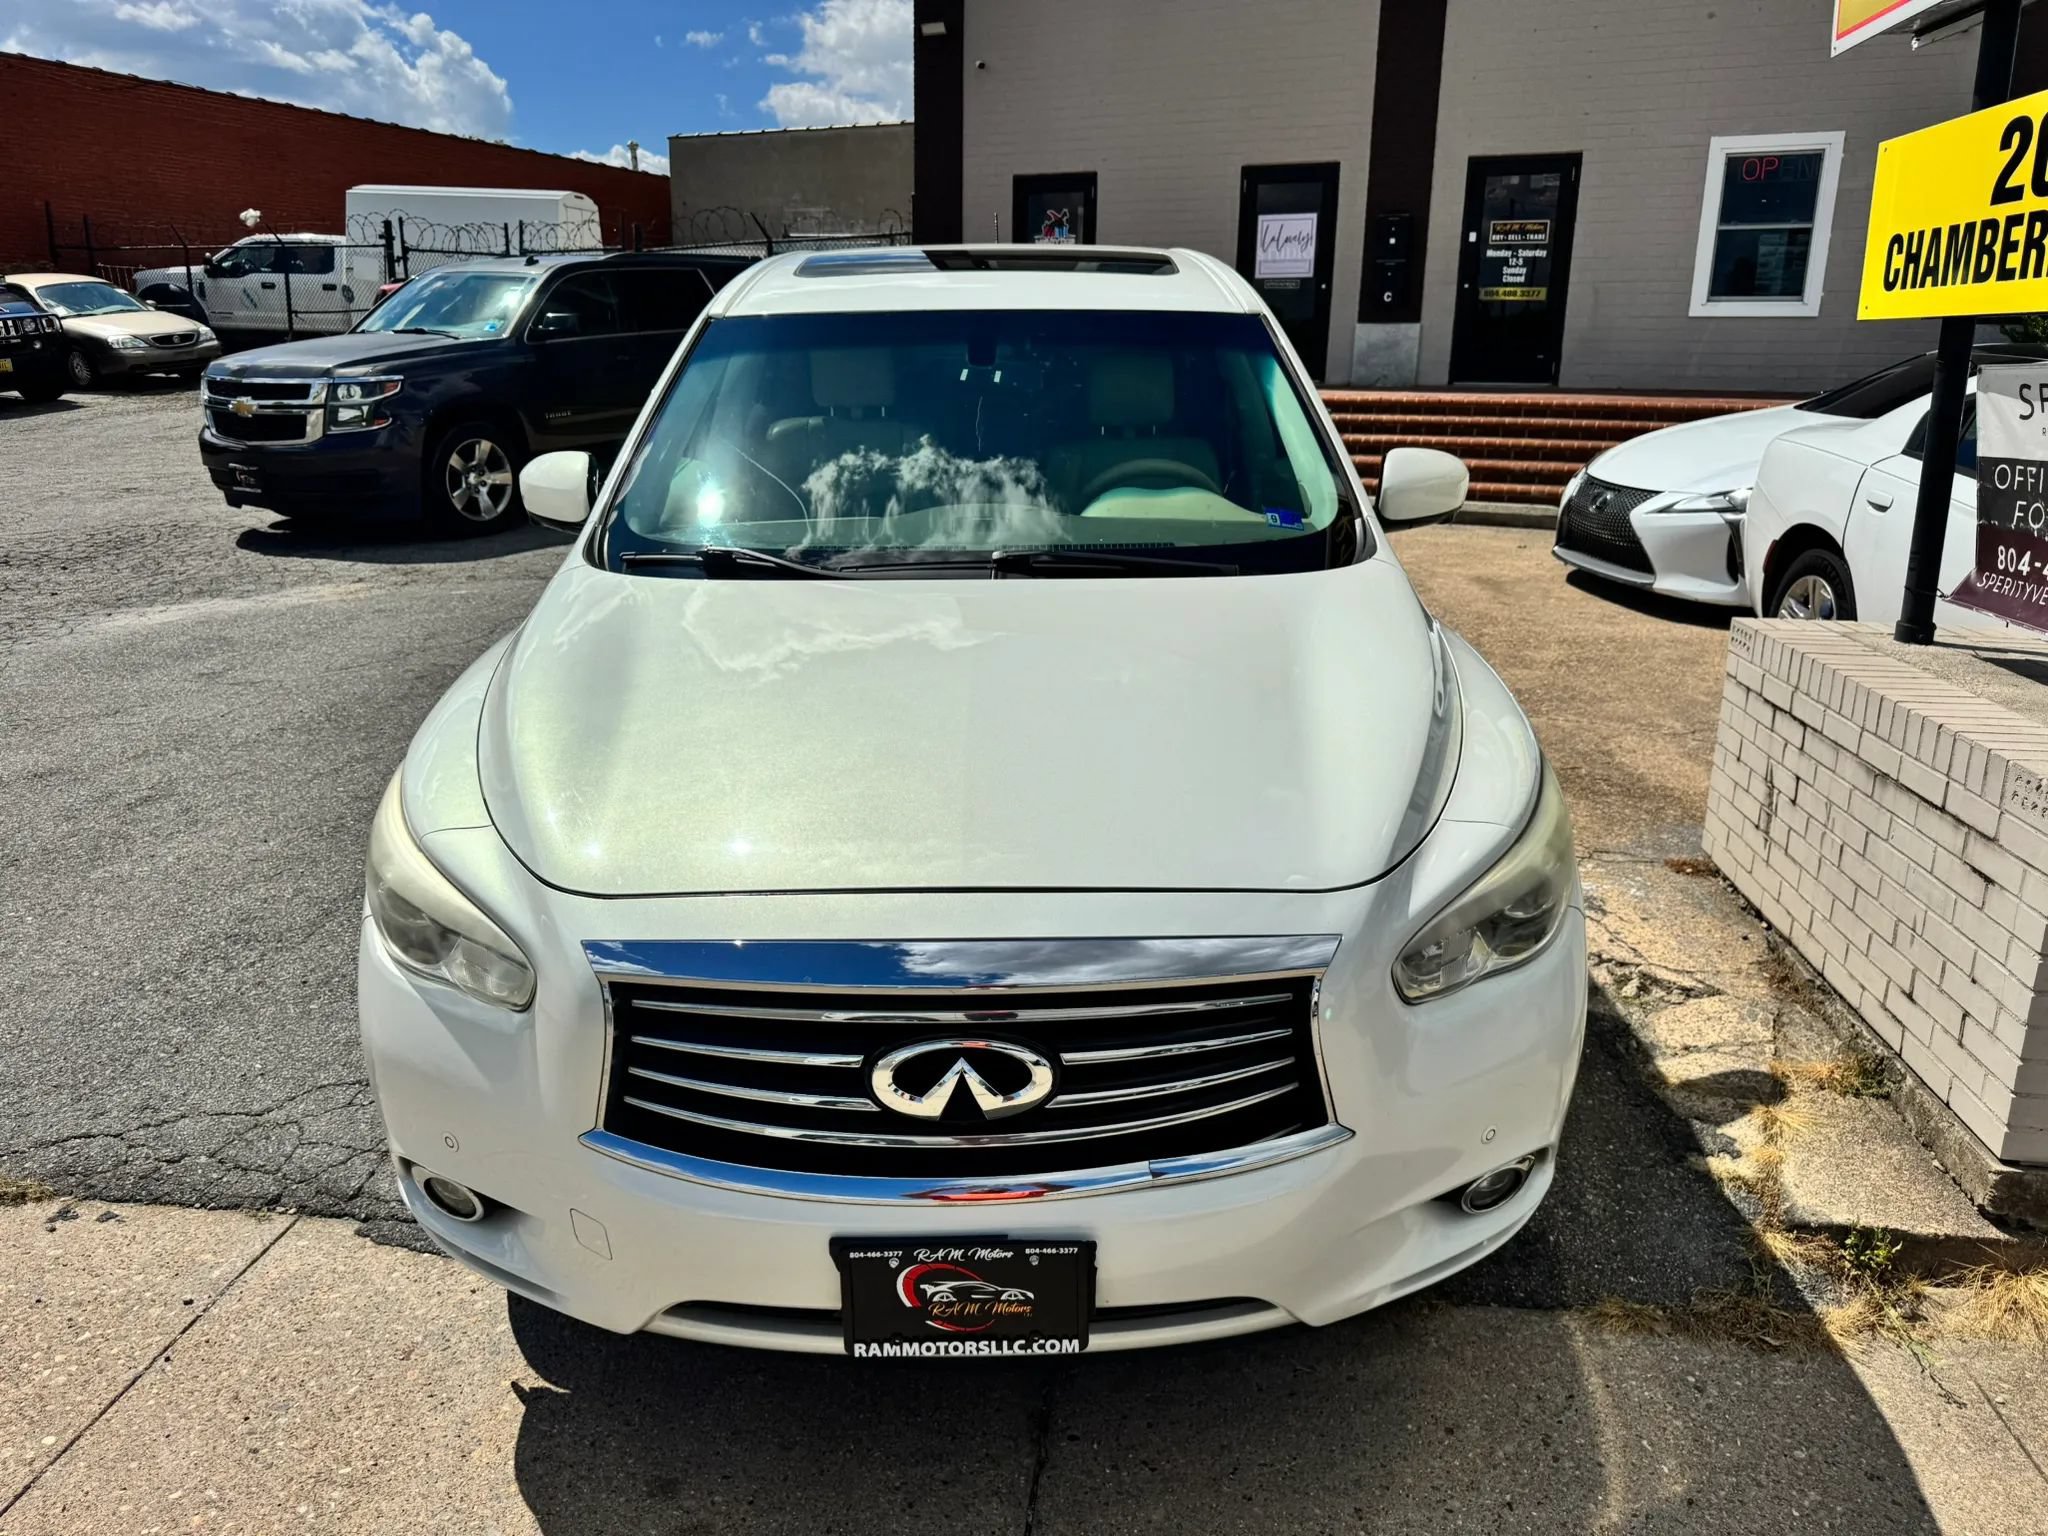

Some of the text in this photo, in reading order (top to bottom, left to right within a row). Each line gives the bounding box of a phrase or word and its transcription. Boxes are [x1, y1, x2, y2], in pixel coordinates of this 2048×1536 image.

[1486, 249, 1512, 257] Monday
[1518, 248, 1547, 258] Saturday
[1884, 209, 2048, 292] CHAMBER
[1502, 266, 1527, 274] Sunday
[1502, 275, 1525, 283] Closed
[1995, 464, 2044, 493] OFFI
[1976, 571, 2048, 606] SPERITYVE
[849, 1250, 902, 1258] 804-466-3377
[913, 1248, 965, 1262] RAM
[968, 1247, 1014, 1261] Motors
[928, 1301, 1032, 1317] RAM Motors
[853, 1338, 1080, 1357] RAMMOTORSLLC.COM
